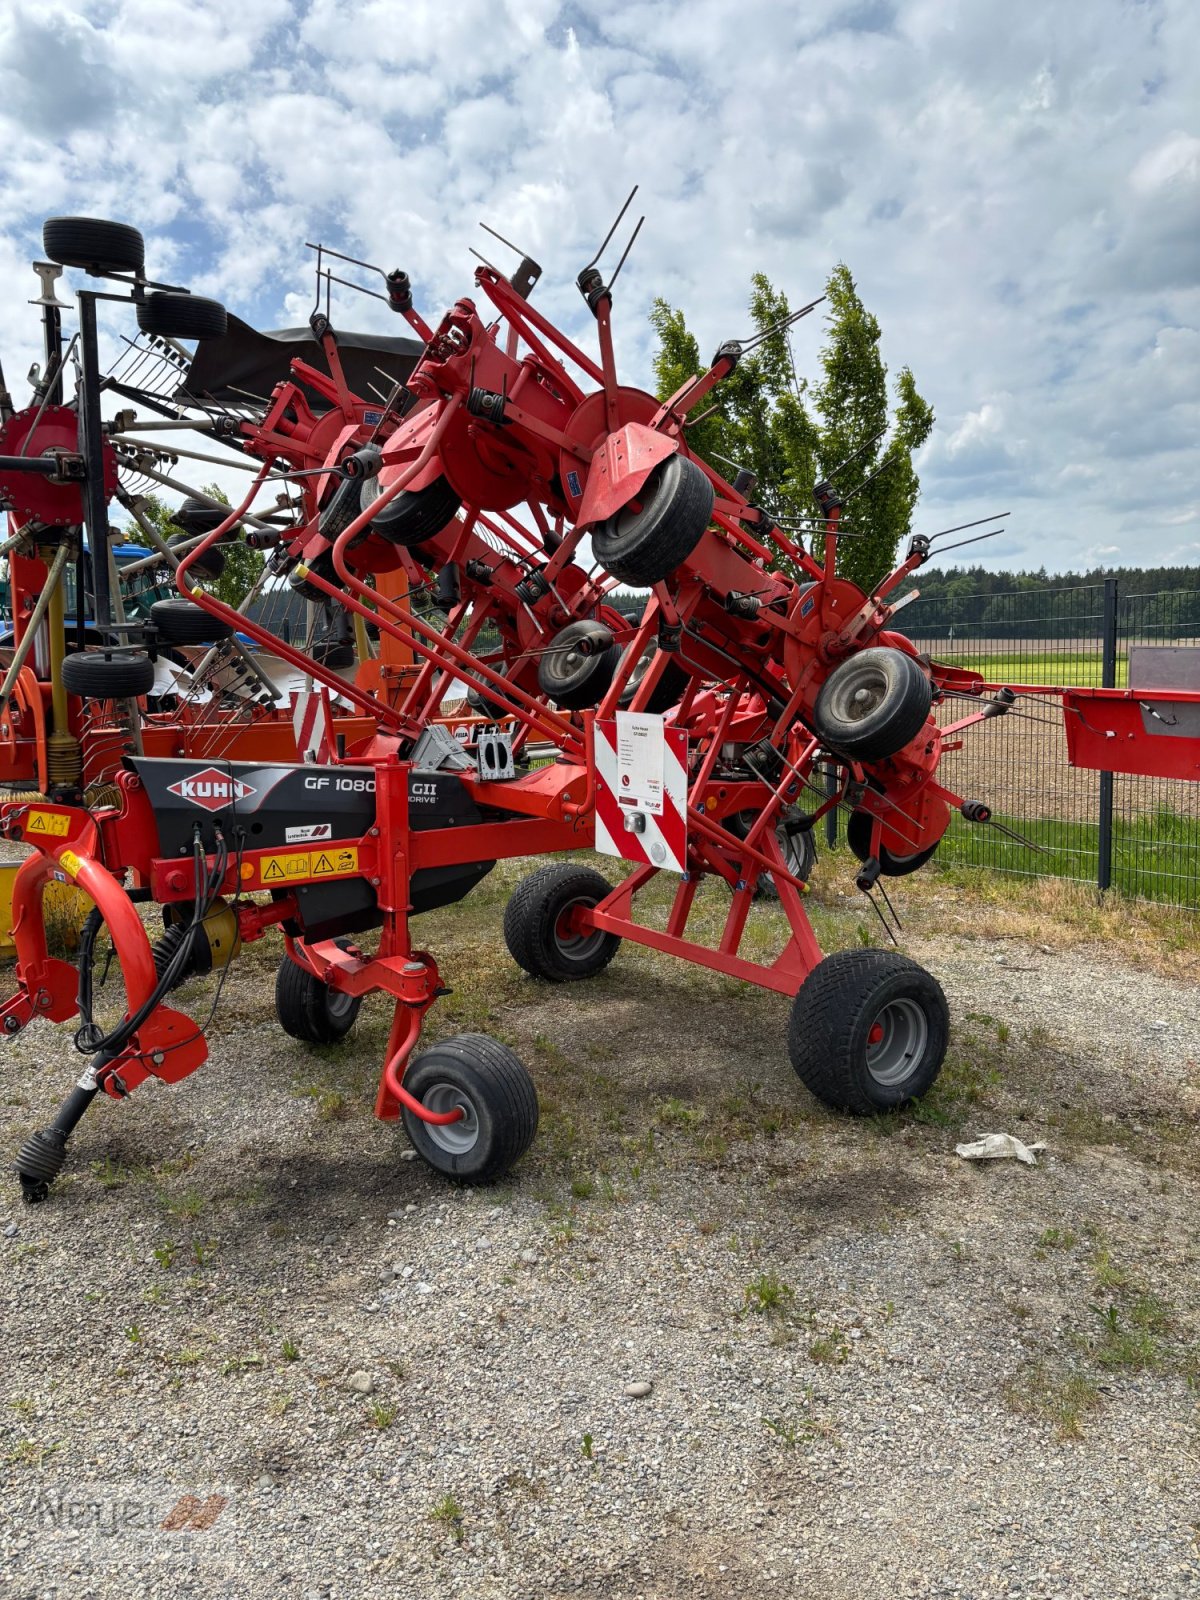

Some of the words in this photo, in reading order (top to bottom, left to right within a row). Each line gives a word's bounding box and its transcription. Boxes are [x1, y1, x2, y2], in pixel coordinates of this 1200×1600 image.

[181, 782, 244, 798] KUHN
[304, 777, 330, 790] GF
[335, 778, 376, 793] 1080
[411, 783, 437, 796] GII
